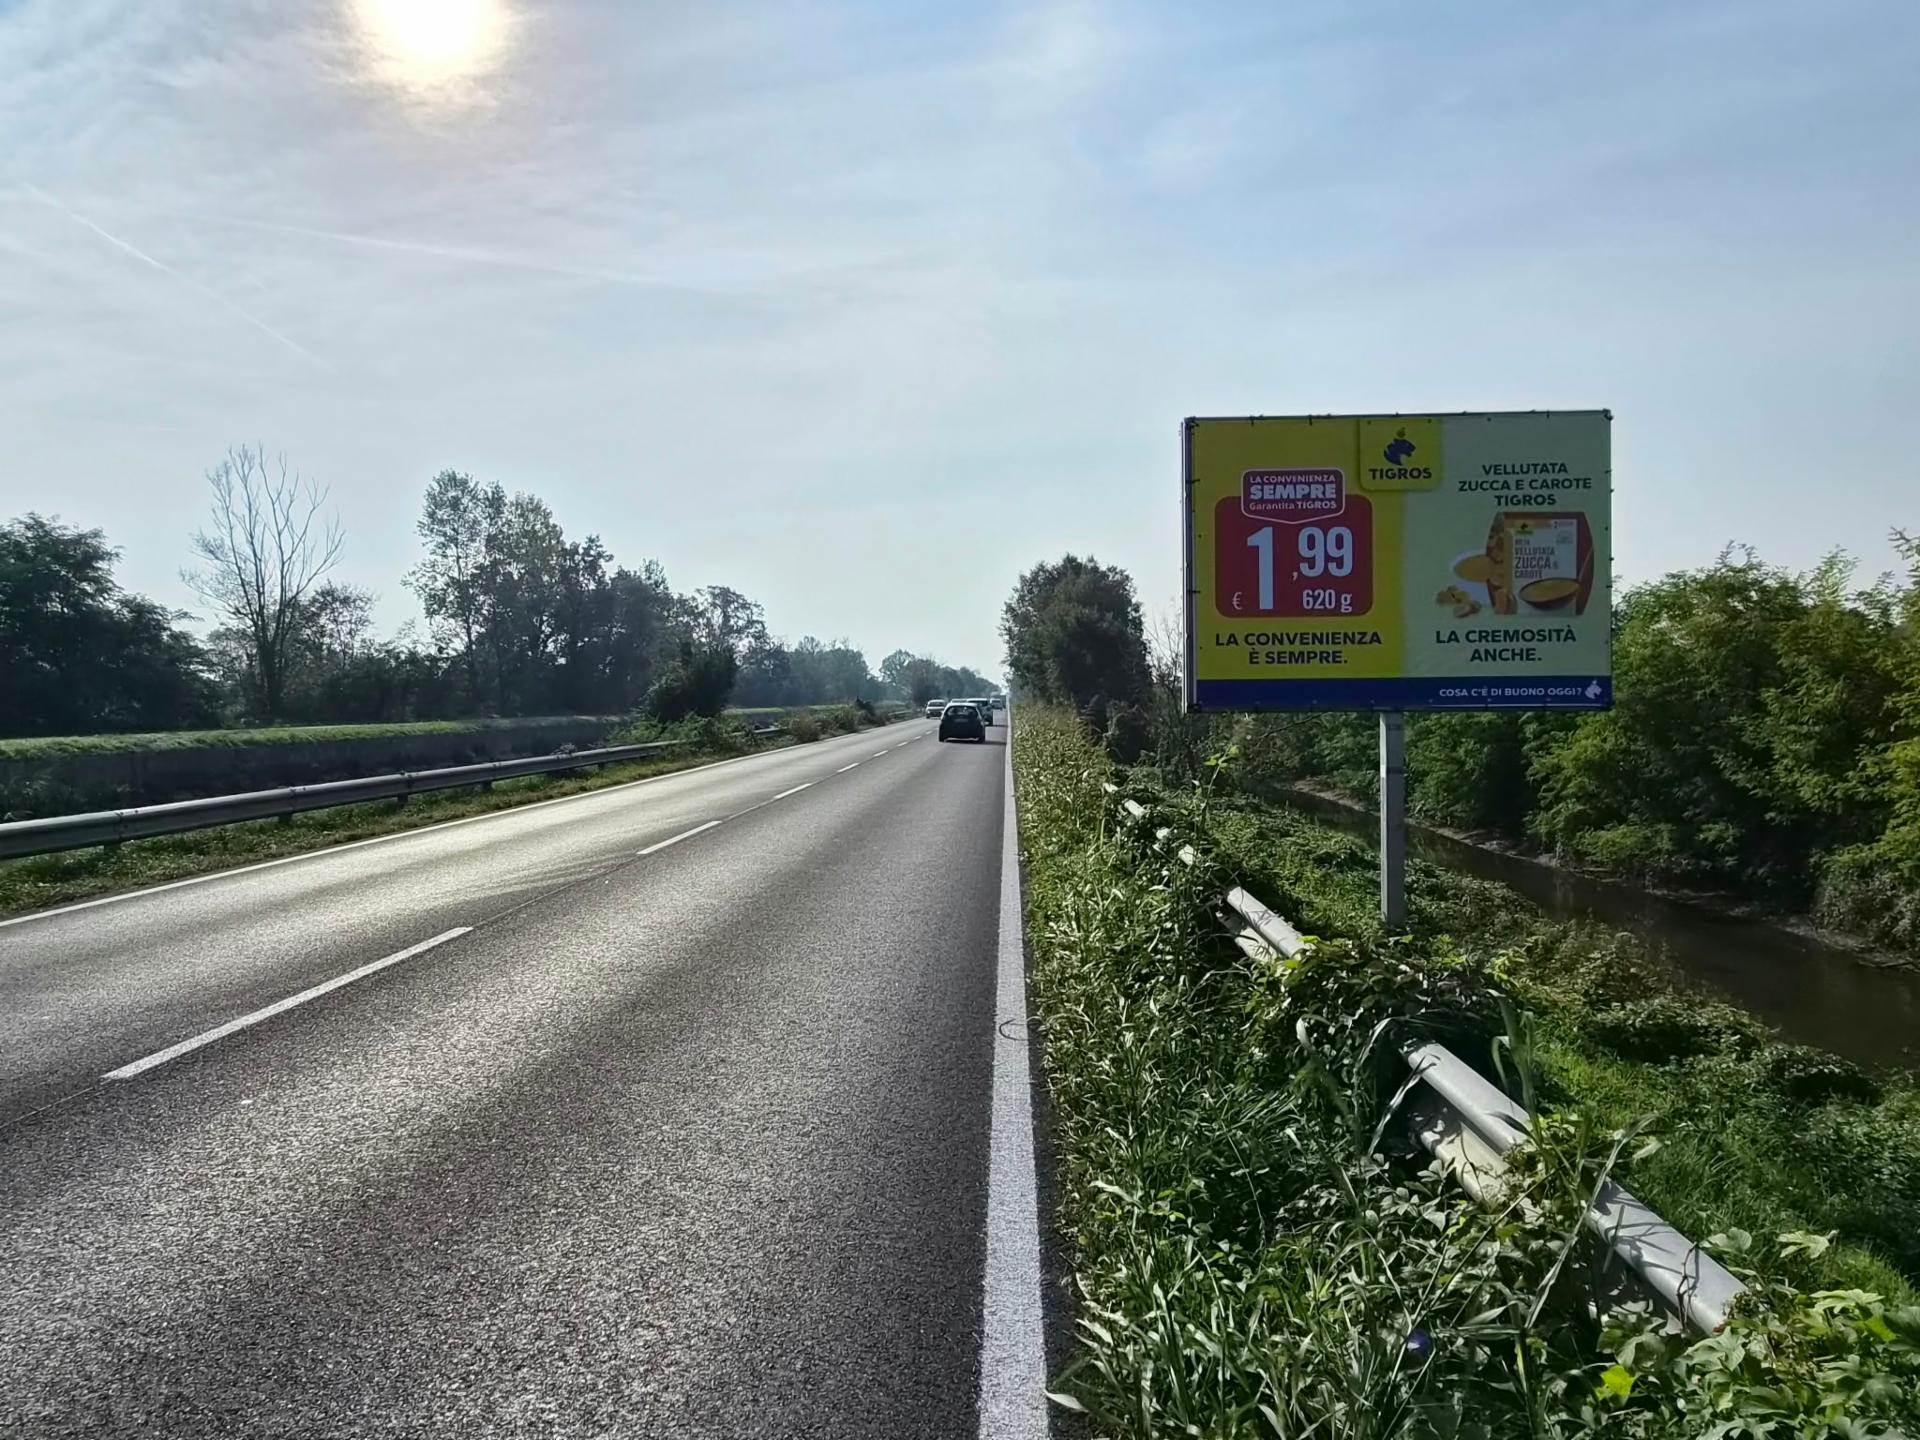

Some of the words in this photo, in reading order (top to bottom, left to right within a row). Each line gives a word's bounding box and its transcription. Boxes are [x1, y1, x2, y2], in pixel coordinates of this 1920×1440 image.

[1369, 467, 1432, 480] TIGROS
[1482, 463, 1568, 476] VELLUTATA
[1250, 475, 1263, 483] LA
[1264, 474, 1336, 483] CONVENIENZA
[1458, 480, 1511, 492] ZUCCA
[1516, 479, 1524, 490] E
[1529, 478, 1592, 491] CAROTE
[1250, 484, 1337, 500] SEMPRE
[1250, 501, 1295, 511] Garantita
[1297, 501, 1337, 510] TIGROS
[1494, 494, 1557, 507] TIGROS
[1515, 557, 1551, 569] ZUCCA
[1232, 592, 1243, 610] €
[1303, 589, 1336, 610] 620
[1340, 593, 1353, 613] g
[1215, 633, 1239, 647] LA
[1244, 632, 1382, 646] CONVENIENZA
[1436, 630, 1460, 644] LA
[1465, 625, 1576, 644] CREMOSITÀ
[1249, 648, 1260, 665] È
[1265, 651, 1348, 665] SEMPRE.
[1469, 648, 1542, 662] ANCHE.
[1439, 688, 1468, 697] COSA
[1491, 688, 1502, 696] DI
[1505, 687, 1545, 696] BUONO
[1547, 686, 1583, 696] OGGI?
